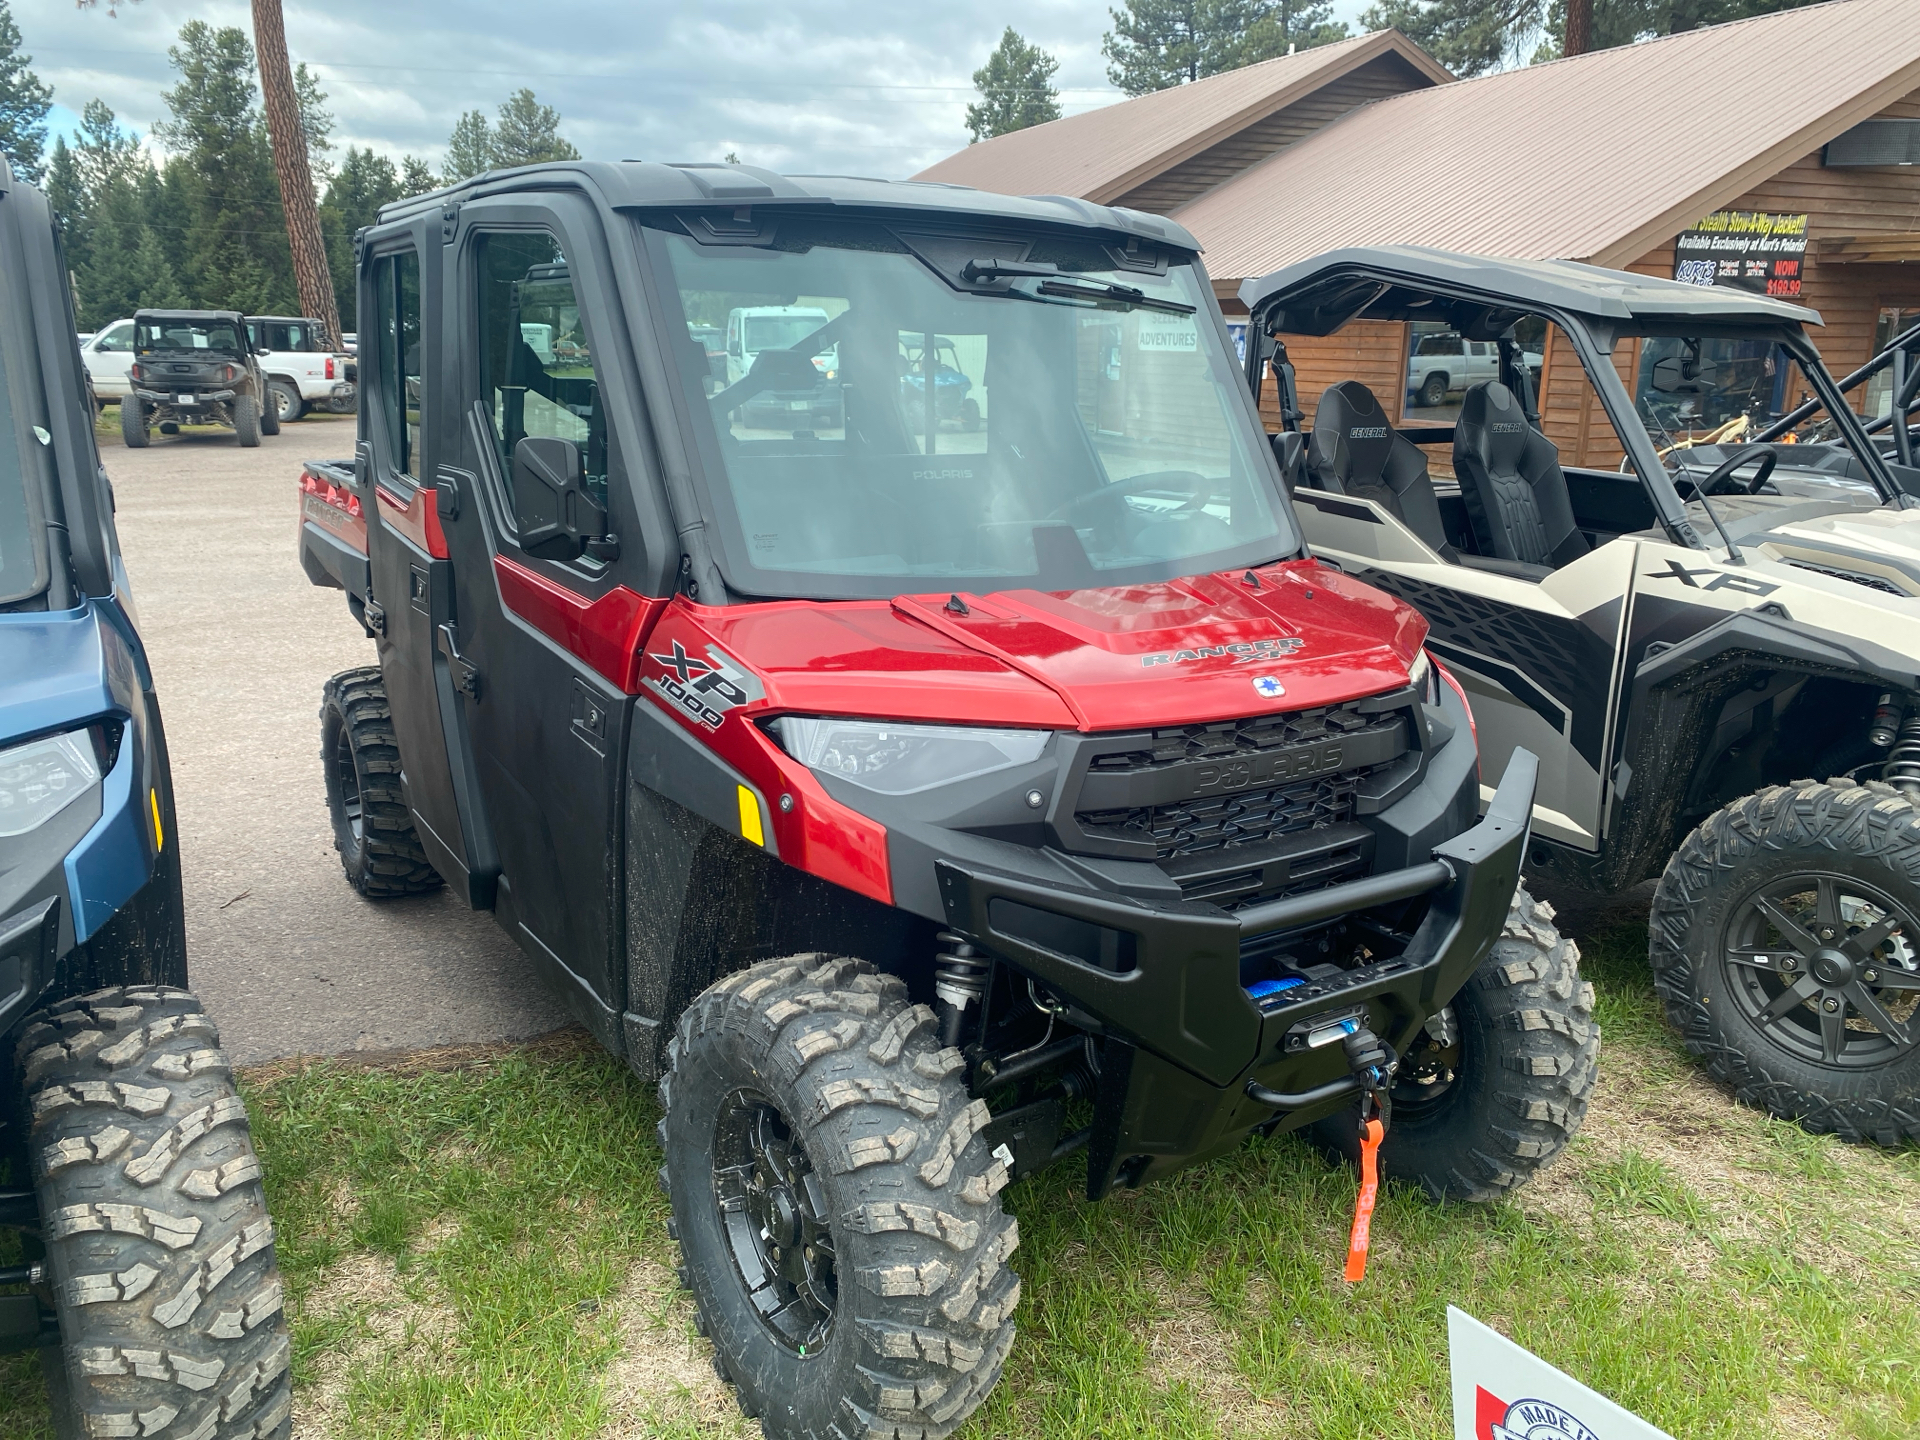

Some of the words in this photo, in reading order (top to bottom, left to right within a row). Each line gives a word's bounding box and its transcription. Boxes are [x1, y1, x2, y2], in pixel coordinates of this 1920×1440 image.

[1700, 211, 1728, 231] Stealth
[1729, 211, 1774, 239] Stow-A-Way
[1773, 214, 1807, 234] Jacket!!!
[1678, 235, 1711, 249] Available
[1711, 236, 1750, 254] Exclusively
[1749, 238, 1761, 252] at
[1760, 237, 1780, 252] Kurt's
[1779, 238, 1807, 253] Polaris!
[1676, 259, 1716, 279] KURT'S
[1775, 260, 1799, 276] NOW!
[1767, 279, 1801, 295] $199.99
[1140, 332, 1196, 347] ADVENTURES
[1350, 426, 1388, 439] GENERAL
[1491, 422, 1523, 433] GENERAL
[912, 469, 974, 481] POLARIS
[307, 496, 345, 532] RANGER
[1642, 558, 1782, 597] XP
[1141, 637, 1307, 668] RANGER
[1230, 648, 1300, 666] XP
[647, 638, 749, 707] XP
[660, 673, 726, 729] 1000
[1193, 743, 1344, 794] POLARIS
[1353, 1183, 1376, 1253] POLARIS
[1518, 1405, 1570, 1432] MADE
